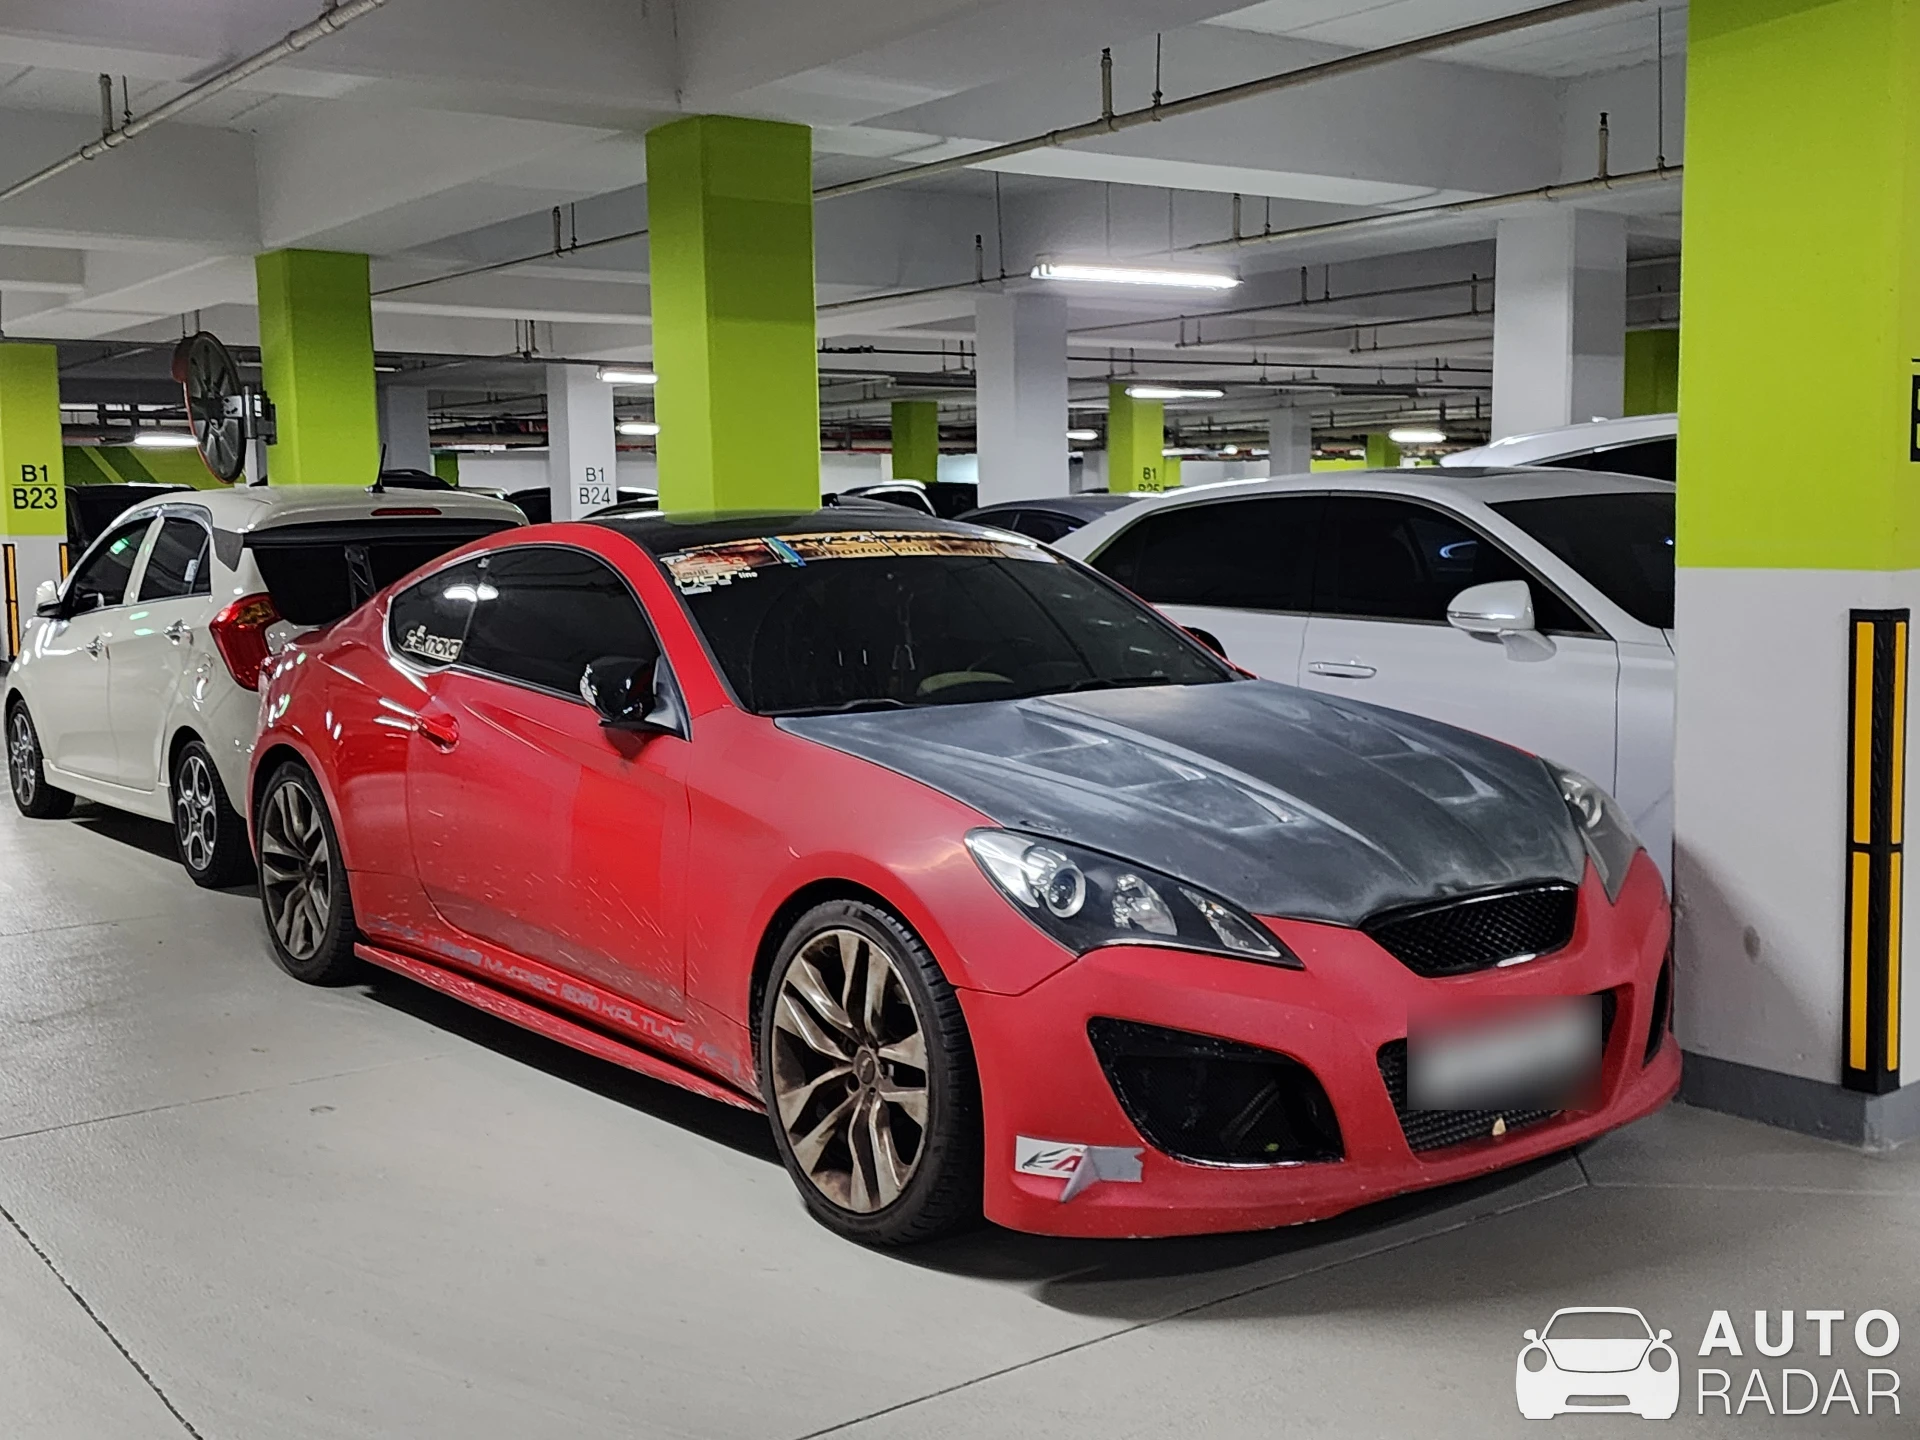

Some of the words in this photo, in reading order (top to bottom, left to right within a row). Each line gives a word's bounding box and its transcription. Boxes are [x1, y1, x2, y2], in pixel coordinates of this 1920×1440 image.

[21, 464, 48, 482] B1
[586, 466, 604, 482] B1
[1143, 467, 1156, 480] B1
[13, 487, 58, 509] B23
[579, 486, 611, 504] B24
